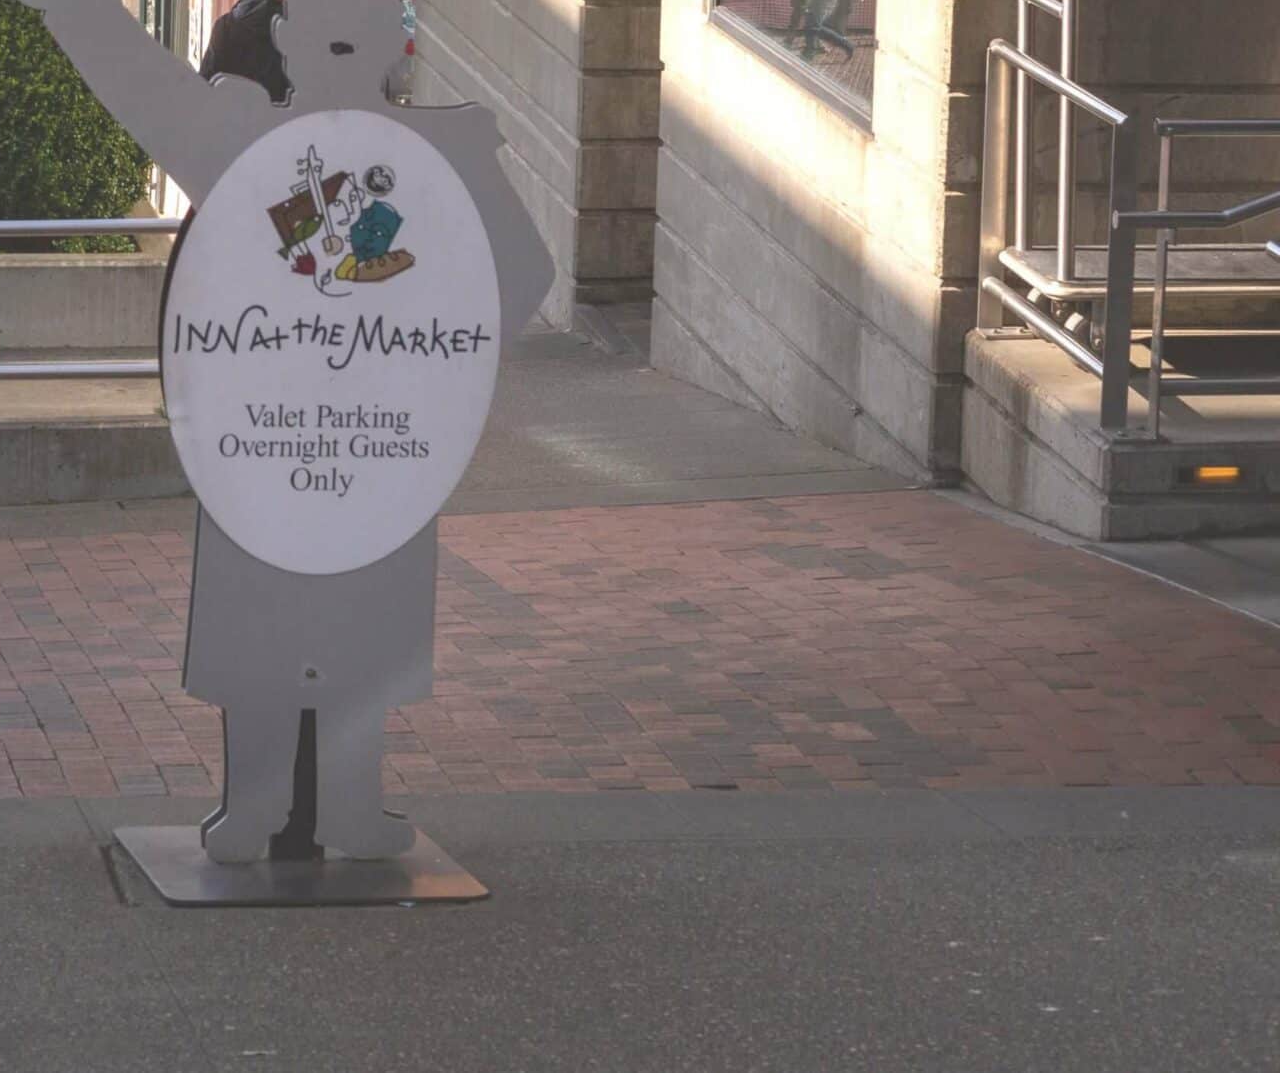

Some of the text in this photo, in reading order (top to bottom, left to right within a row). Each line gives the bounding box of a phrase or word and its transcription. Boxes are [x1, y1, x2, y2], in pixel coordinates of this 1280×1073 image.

[173, 304, 268, 354] INN
[245, 403, 411, 435] Valet Parking
[219, 433, 430, 464] Overnight Guests
[290, 467, 356, 498] Only
